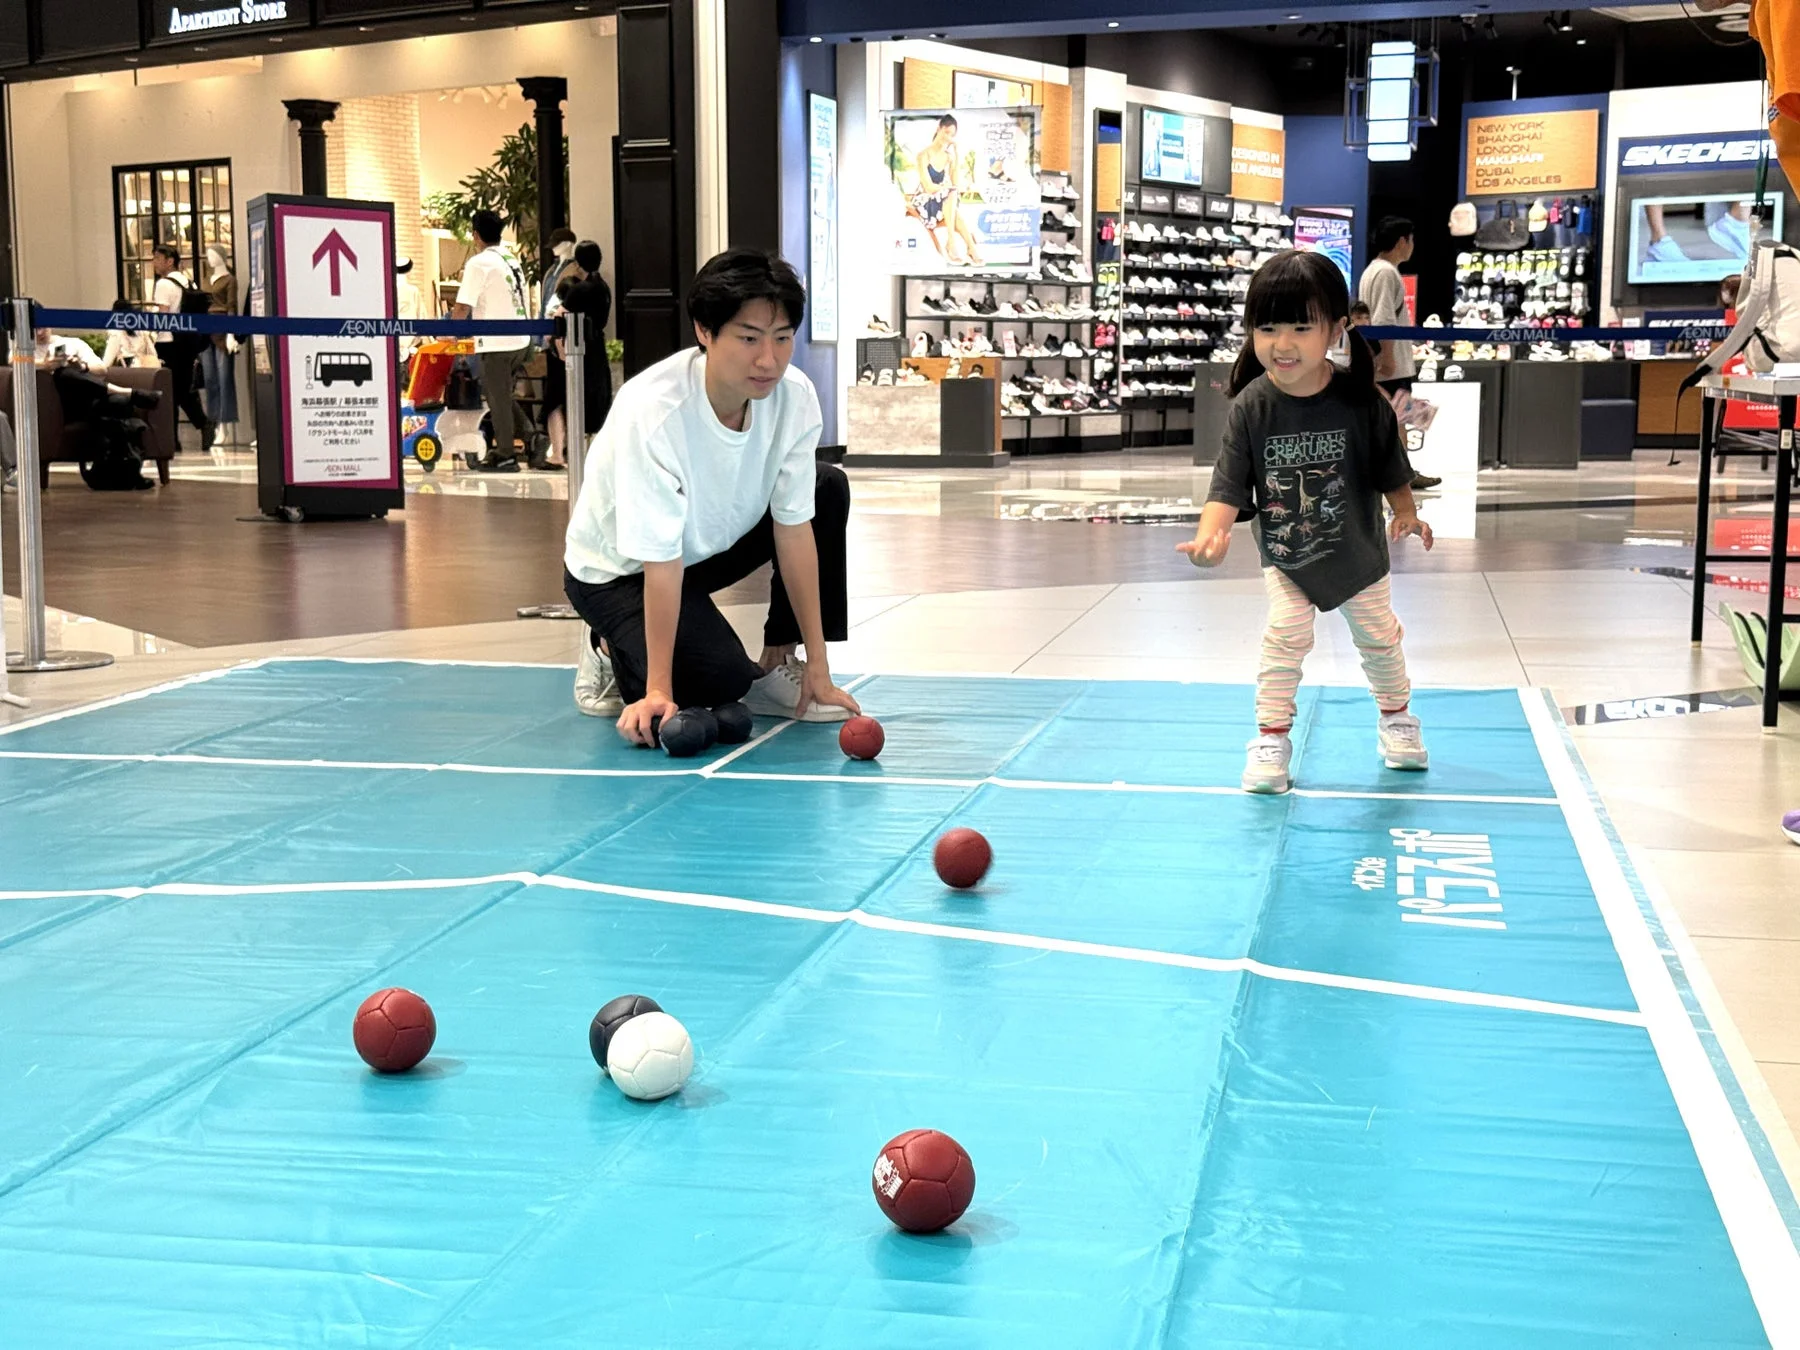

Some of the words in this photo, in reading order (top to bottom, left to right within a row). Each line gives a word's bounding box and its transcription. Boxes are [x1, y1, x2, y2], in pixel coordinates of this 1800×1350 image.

[1476, 124, 1506, 134] NEW
[1509, 120, 1545, 131] YORK
[1476, 132, 1543, 145] SHANGHAI
[1476, 144, 1530, 156] LONDON
[1621, 138, 1778, 167] SKECHER
[1475, 153, 1544, 166] MAKUHARI
[1475, 166, 1514, 177] DUBAI
[1475, 178, 1500, 188] LOS
[1503, 175, 1562, 187] ANGELES
[153, 314, 198, 332] MALL
[380, 320, 417, 335] MALL
[1523, 328, 1559, 341] MALL
[1263, 439, 1346, 461] CREATURES
[1388, 828, 1508, 930] パラスポ
